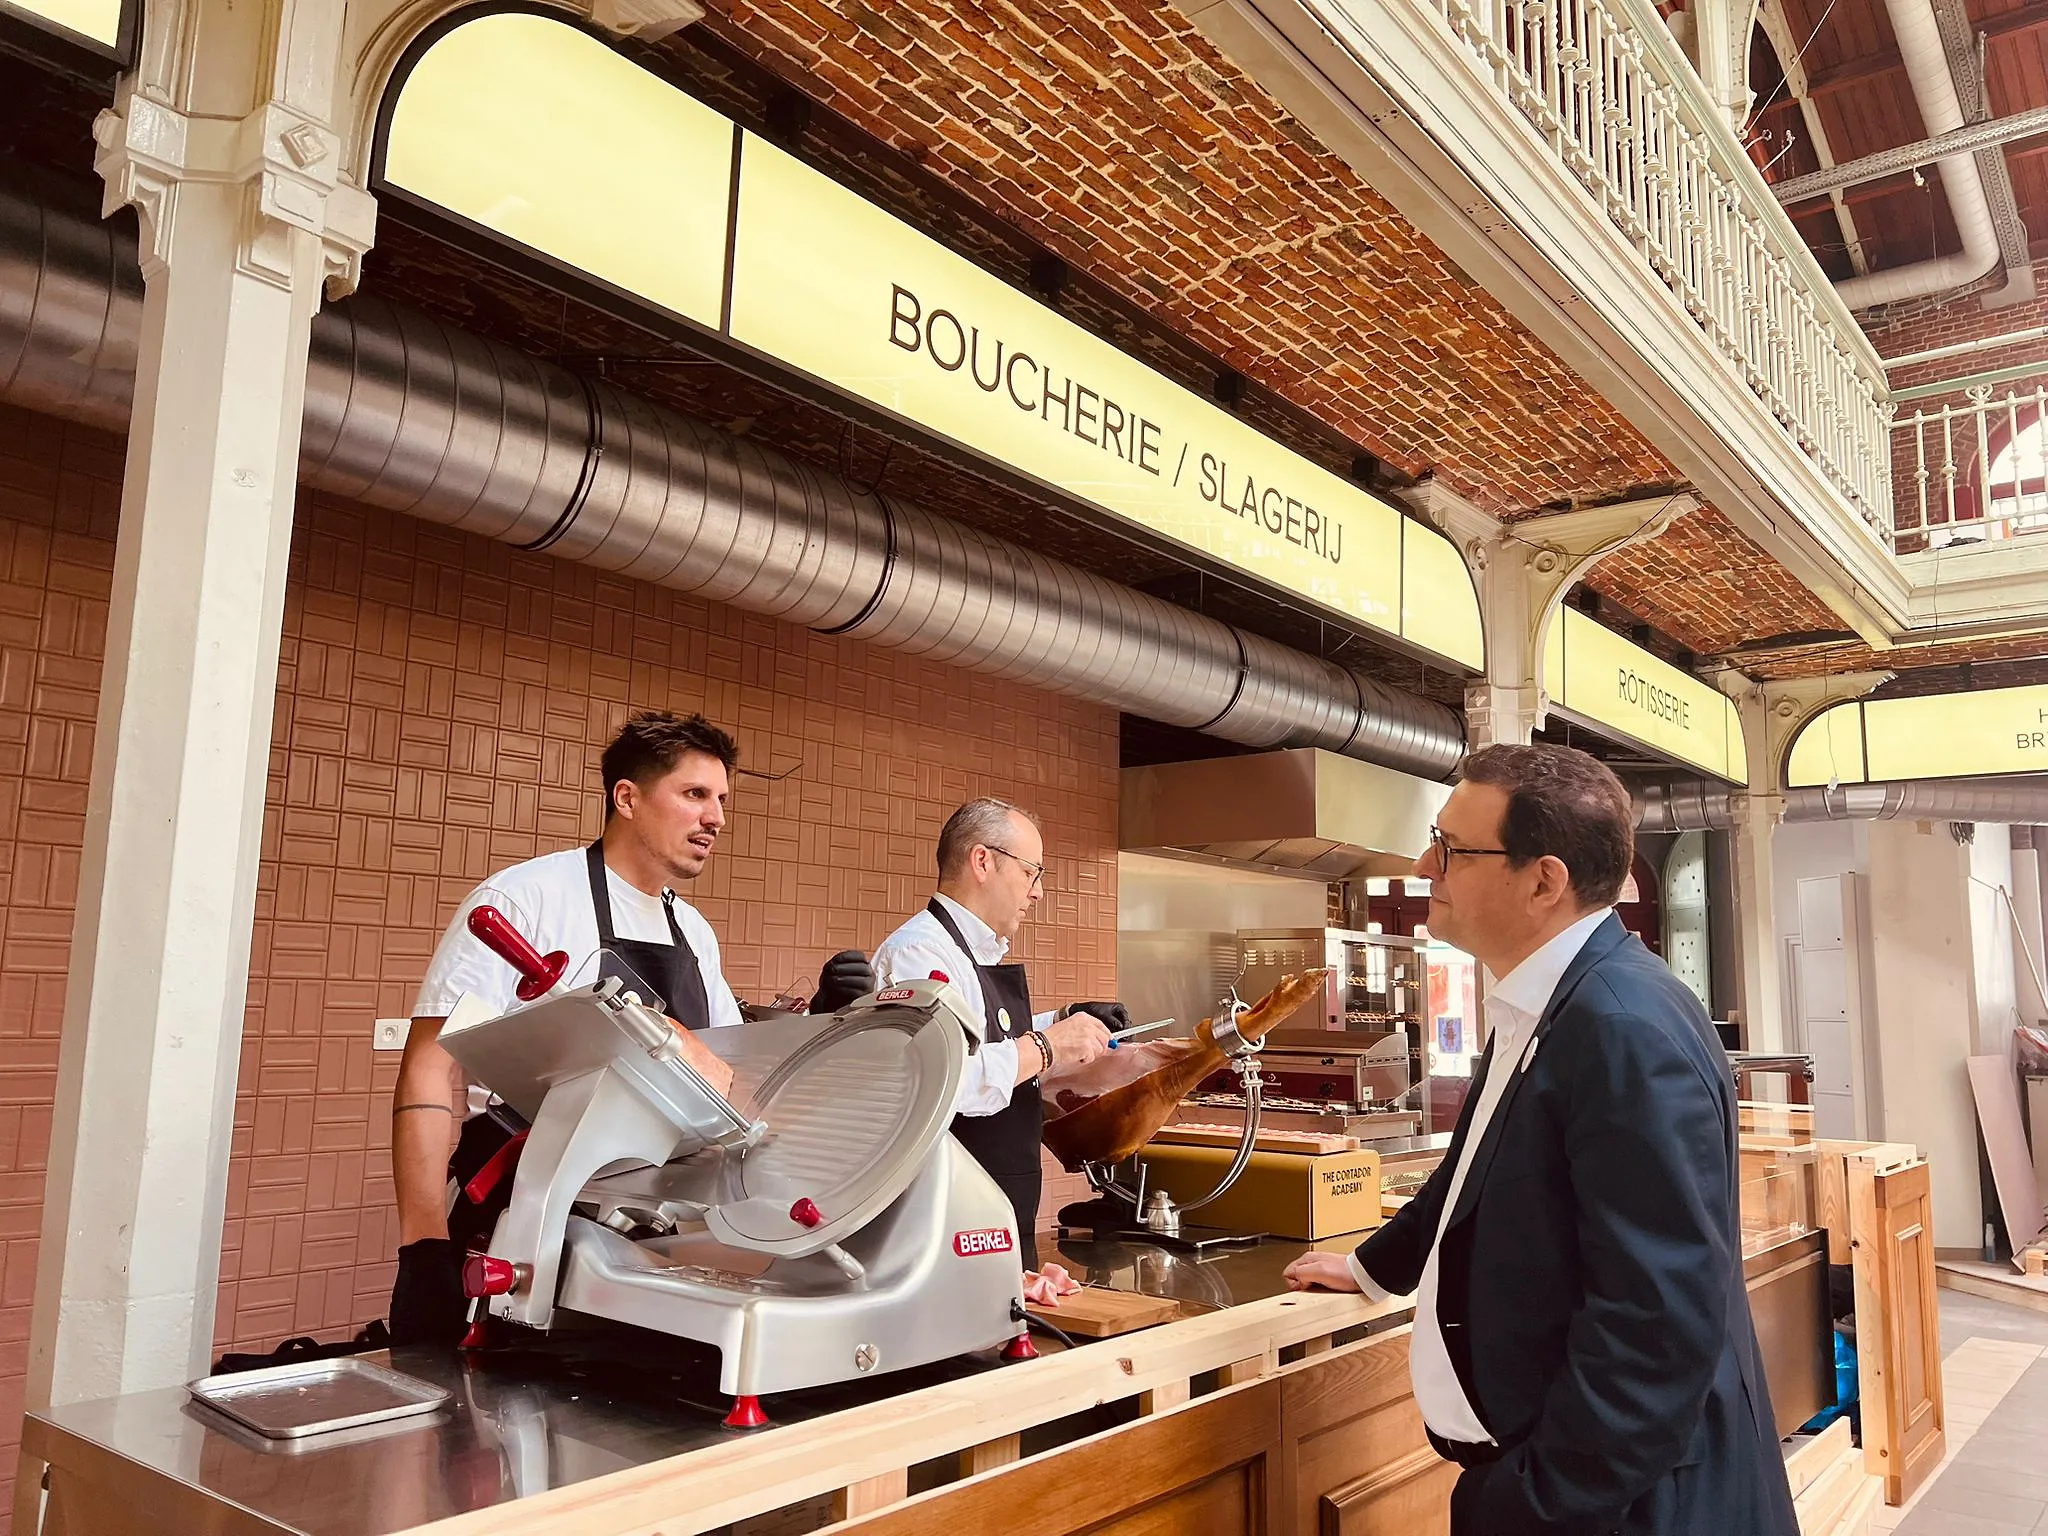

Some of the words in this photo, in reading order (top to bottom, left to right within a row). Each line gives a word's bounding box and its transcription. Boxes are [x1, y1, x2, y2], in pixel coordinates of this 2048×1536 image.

[889, 282, 1161, 476] BOUCHERIE
[1199, 452, 1342, 564] SLAGERIJ
[1618, 668, 1690, 730] RÔTISSERIE
[2016, 732, 2048, 748] BR
[878, 990, 910, 1000] BERKEL
[1322, 1171, 1335, 1183] THE
[1335, 1166, 1371, 1181] CORTADOR
[1331, 1181, 1363, 1197] ACADEMY
[959, 1230, 1010, 1253] BERKEL
